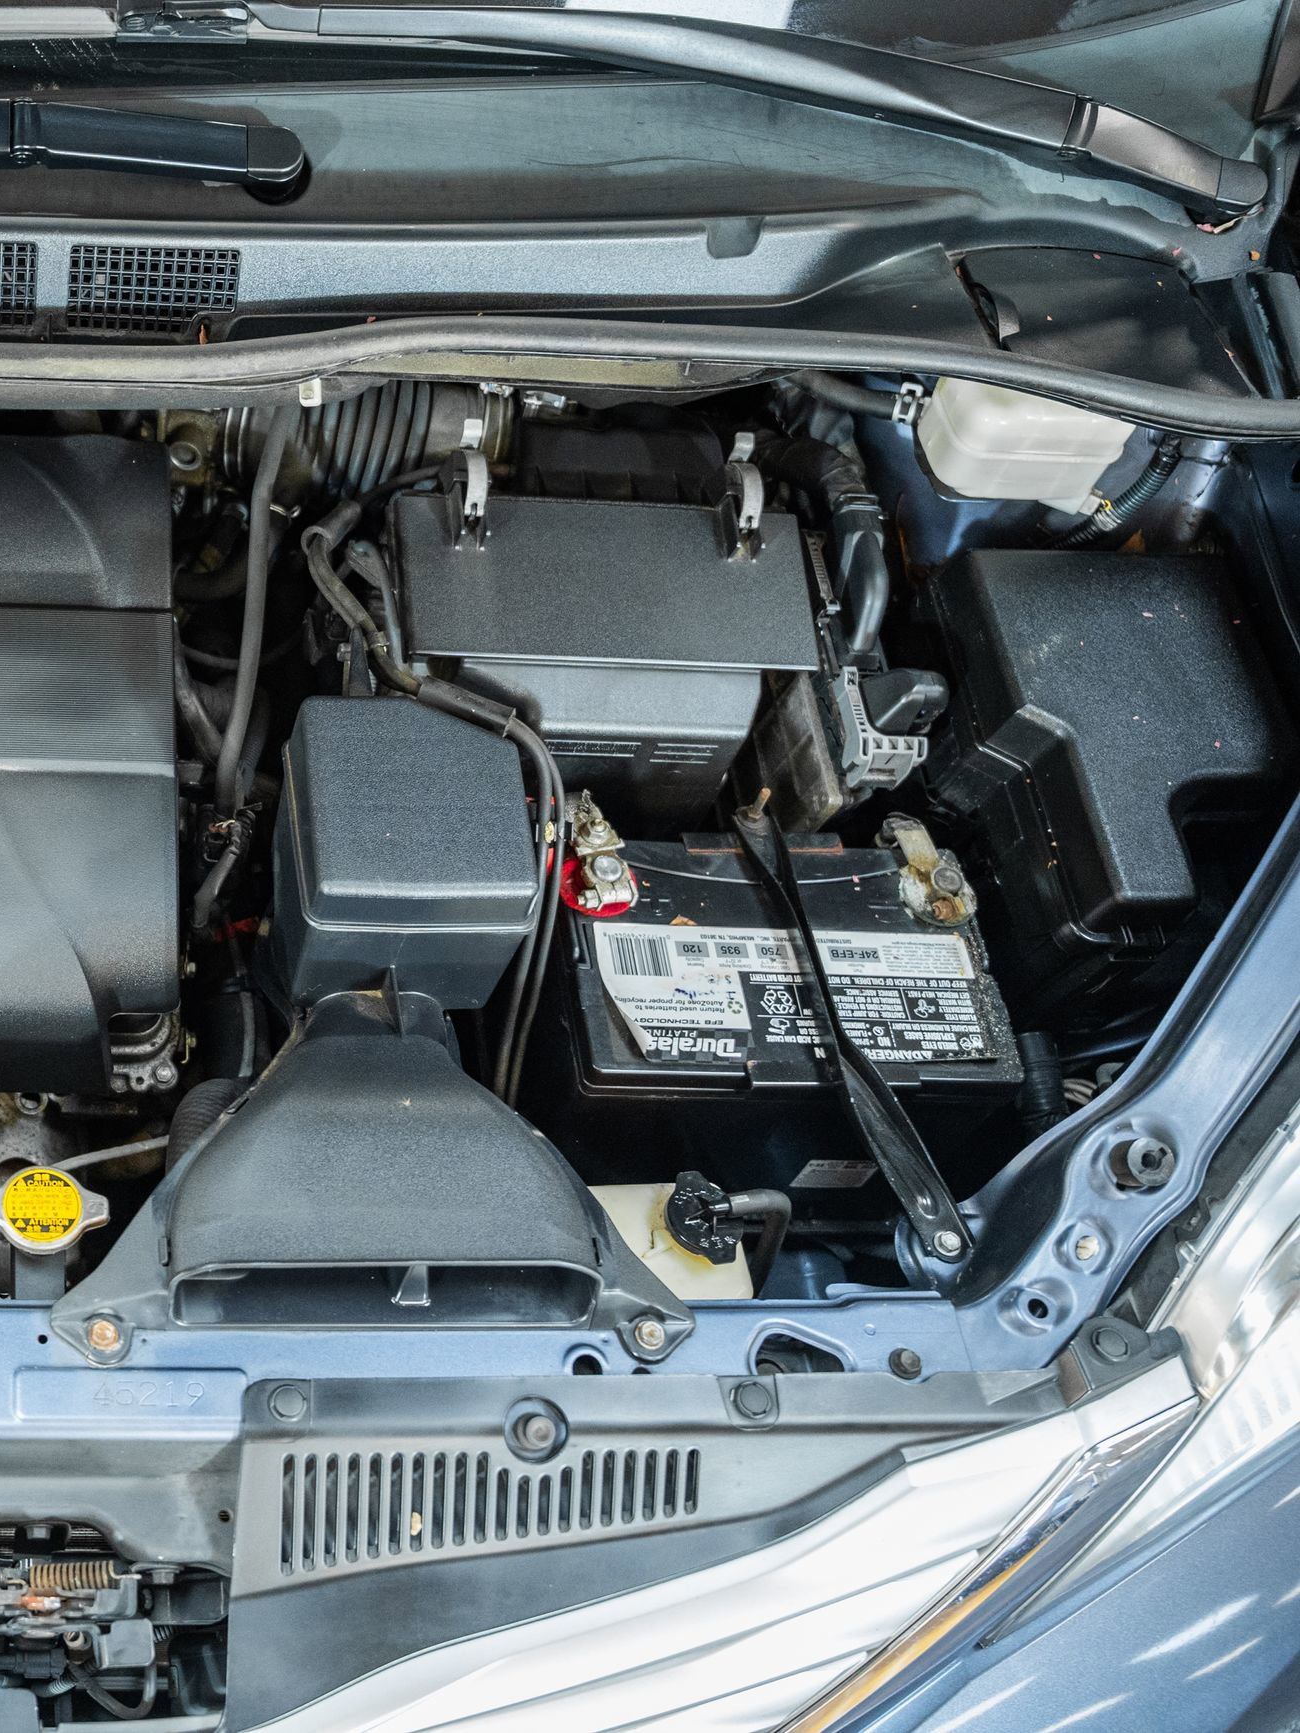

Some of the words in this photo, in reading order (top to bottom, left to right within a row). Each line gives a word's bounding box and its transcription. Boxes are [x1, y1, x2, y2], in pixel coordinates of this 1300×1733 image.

[681, 944, 703, 954] 120
[719, 945, 741, 956] 935
[760, 946, 782, 956] 750
[830, 948, 880, 959] 24F-EFB
[776, 974, 793, 983] OPEN
[827, 976, 840, 984] NOT
[840, 977, 851, 985] DO
[852, 977, 884, 986] CHILDREN.
[883, 978, 893, 986] OF
[894, 978, 914, 987] REACH
[914, 979, 928, 987] THE
[951, 980, 968, 988] KEEP
[877, 989, 900, 997] SERVICE
[613, 994, 647, 1004] recycling
[687, 999, 723, 1007] AutoZone
[645, 1003, 678, 1012] batteries
[679, 1005, 698, 1013] used
[699, 1005, 725, 1014] Return
[867, 1010, 879, 1018] FOR
[633, 1017, 700, 1025] TECHNOLOGY
[765, 1034, 784, 1043] CAUSE
[784, 1035, 797, 1043] CAN
[796, 1035, 812, 1044] ACID
[903, 1030, 923, 1040] GASES
[924, 1031, 957, 1041] EXPLOSIVE
[876, 1036, 891, 1047] NO
[920, 1040, 937, 1049] EYES
[937, 1041, 959, 1050] SHIELD
[644, 1036, 742, 1058] Duralas
[29, 1218, 69, 1226] ATTENTION
[92, 1380, 205, 1407] 45219
